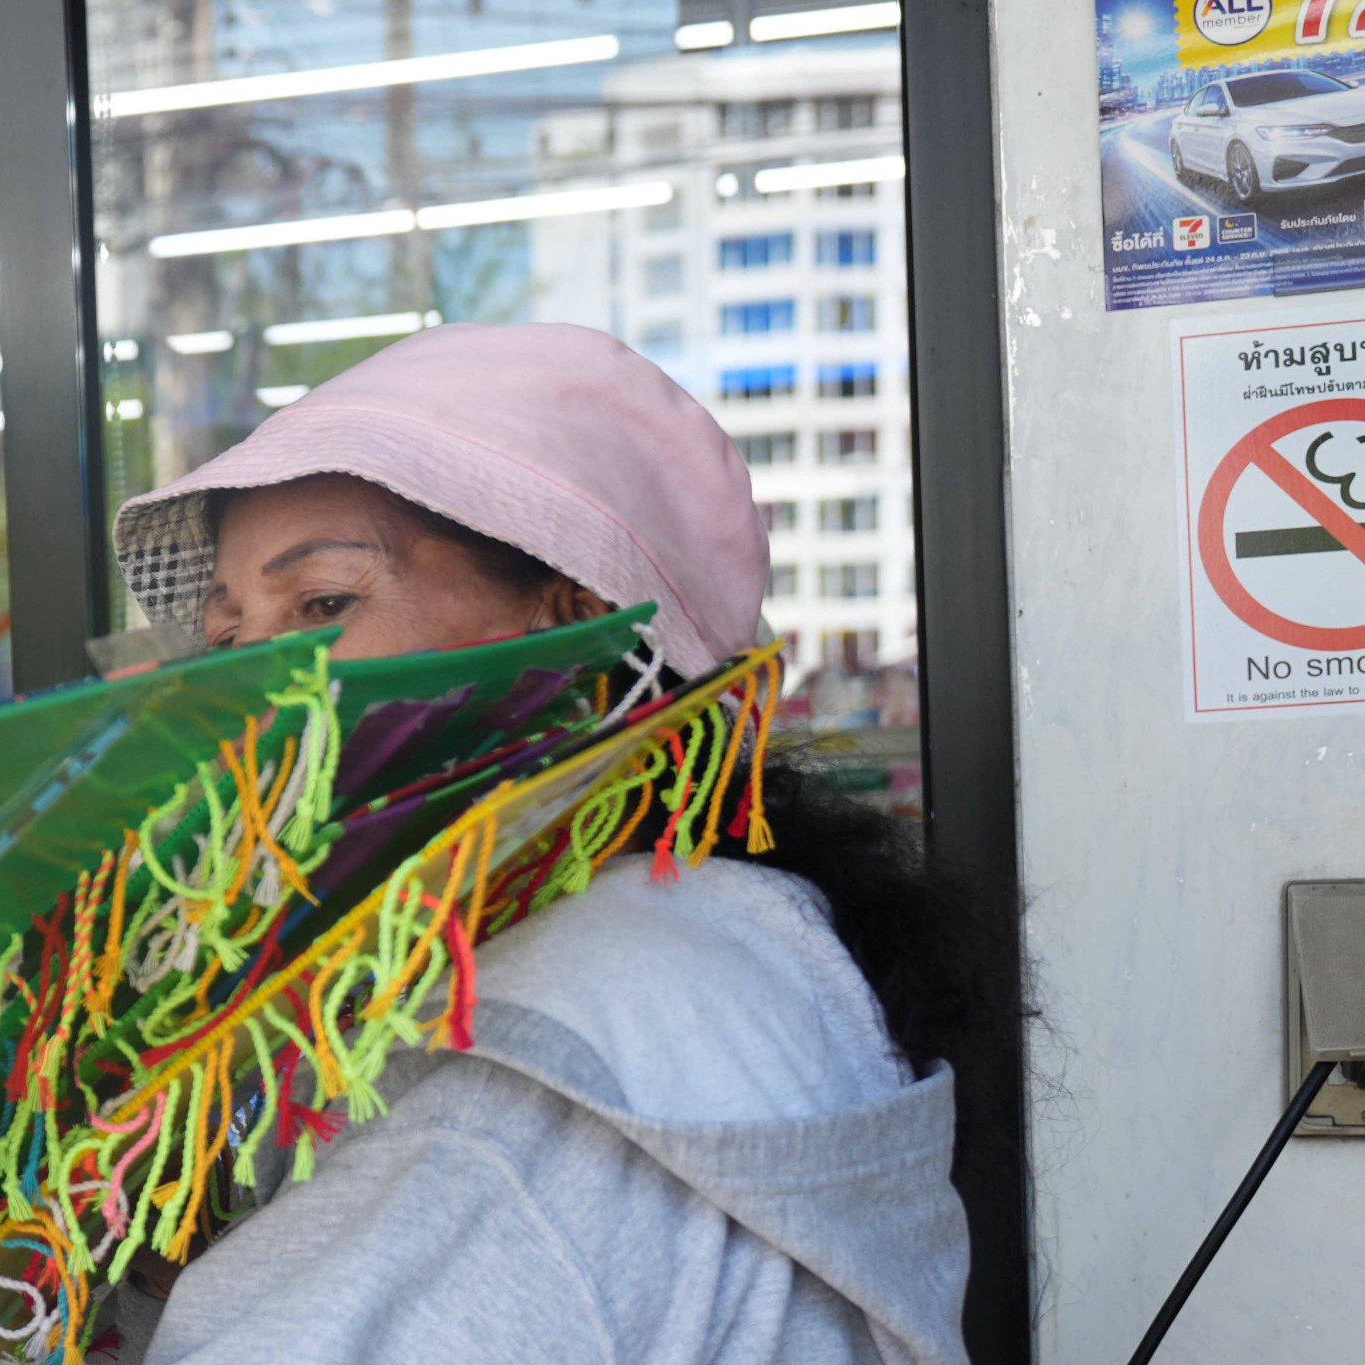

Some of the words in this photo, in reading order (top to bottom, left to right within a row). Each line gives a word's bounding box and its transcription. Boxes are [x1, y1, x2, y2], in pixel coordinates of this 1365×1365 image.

[1202, 14, 1261, 29] member
[1280, 212, 1357, 230] รับประกันภัยโดย
[1111, 226, 1165, 252] ซื้อได้ที่
[1238, 340, 1365, 377] ห้ามสูบ
[1247, 656, 1291, 681] No
[1226, 693, 1233, 703] It
[1238, 692, 1248, 702] is
[1252, 689, 1296, 703] against
[1301, 688, 1318, 698] the
[1324, 687, 1343, 696] law
[1349, 686, 1360, 695] to
